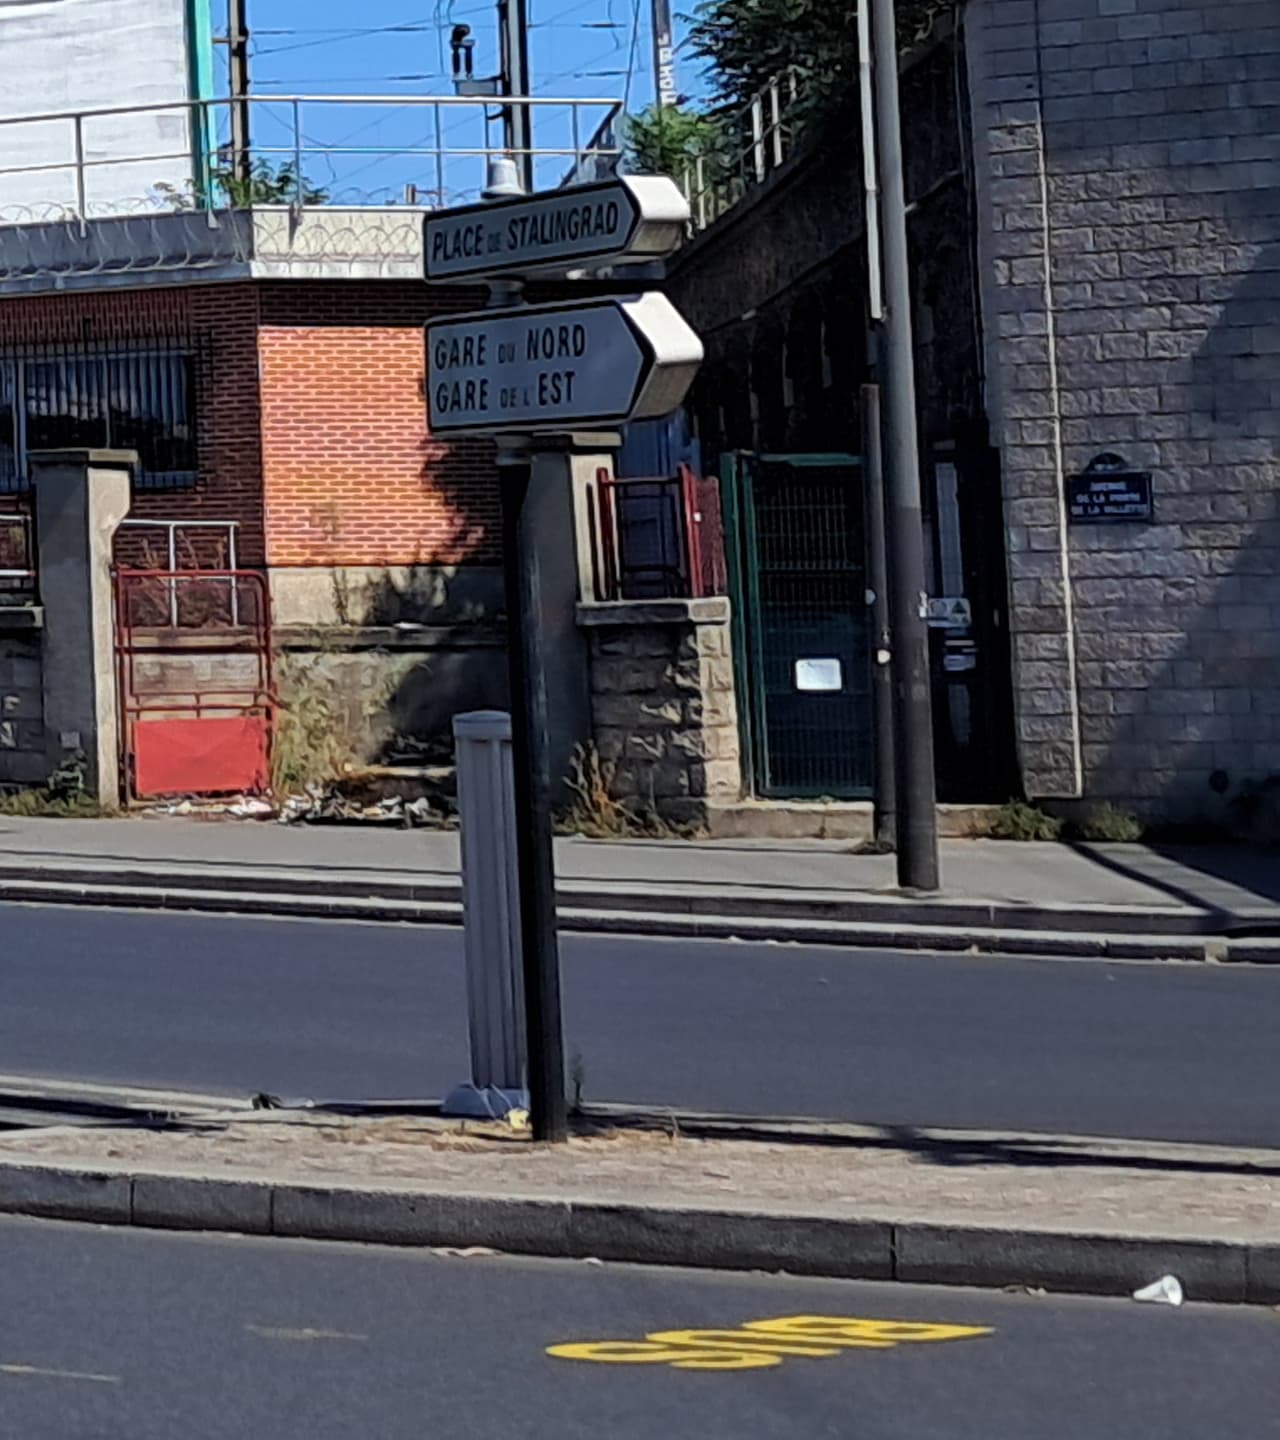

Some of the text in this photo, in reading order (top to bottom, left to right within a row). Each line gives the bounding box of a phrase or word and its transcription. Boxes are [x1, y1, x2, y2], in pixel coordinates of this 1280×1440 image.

[432, 201, 619, 261] PLACE DE STALINGRAD
[434, 323, 586, 370] GARE DU NORD
[435, 378, 489, 413] GARE
[500, 388, 517, 407] DE
[545, 1315, 996, 1370] BUS
